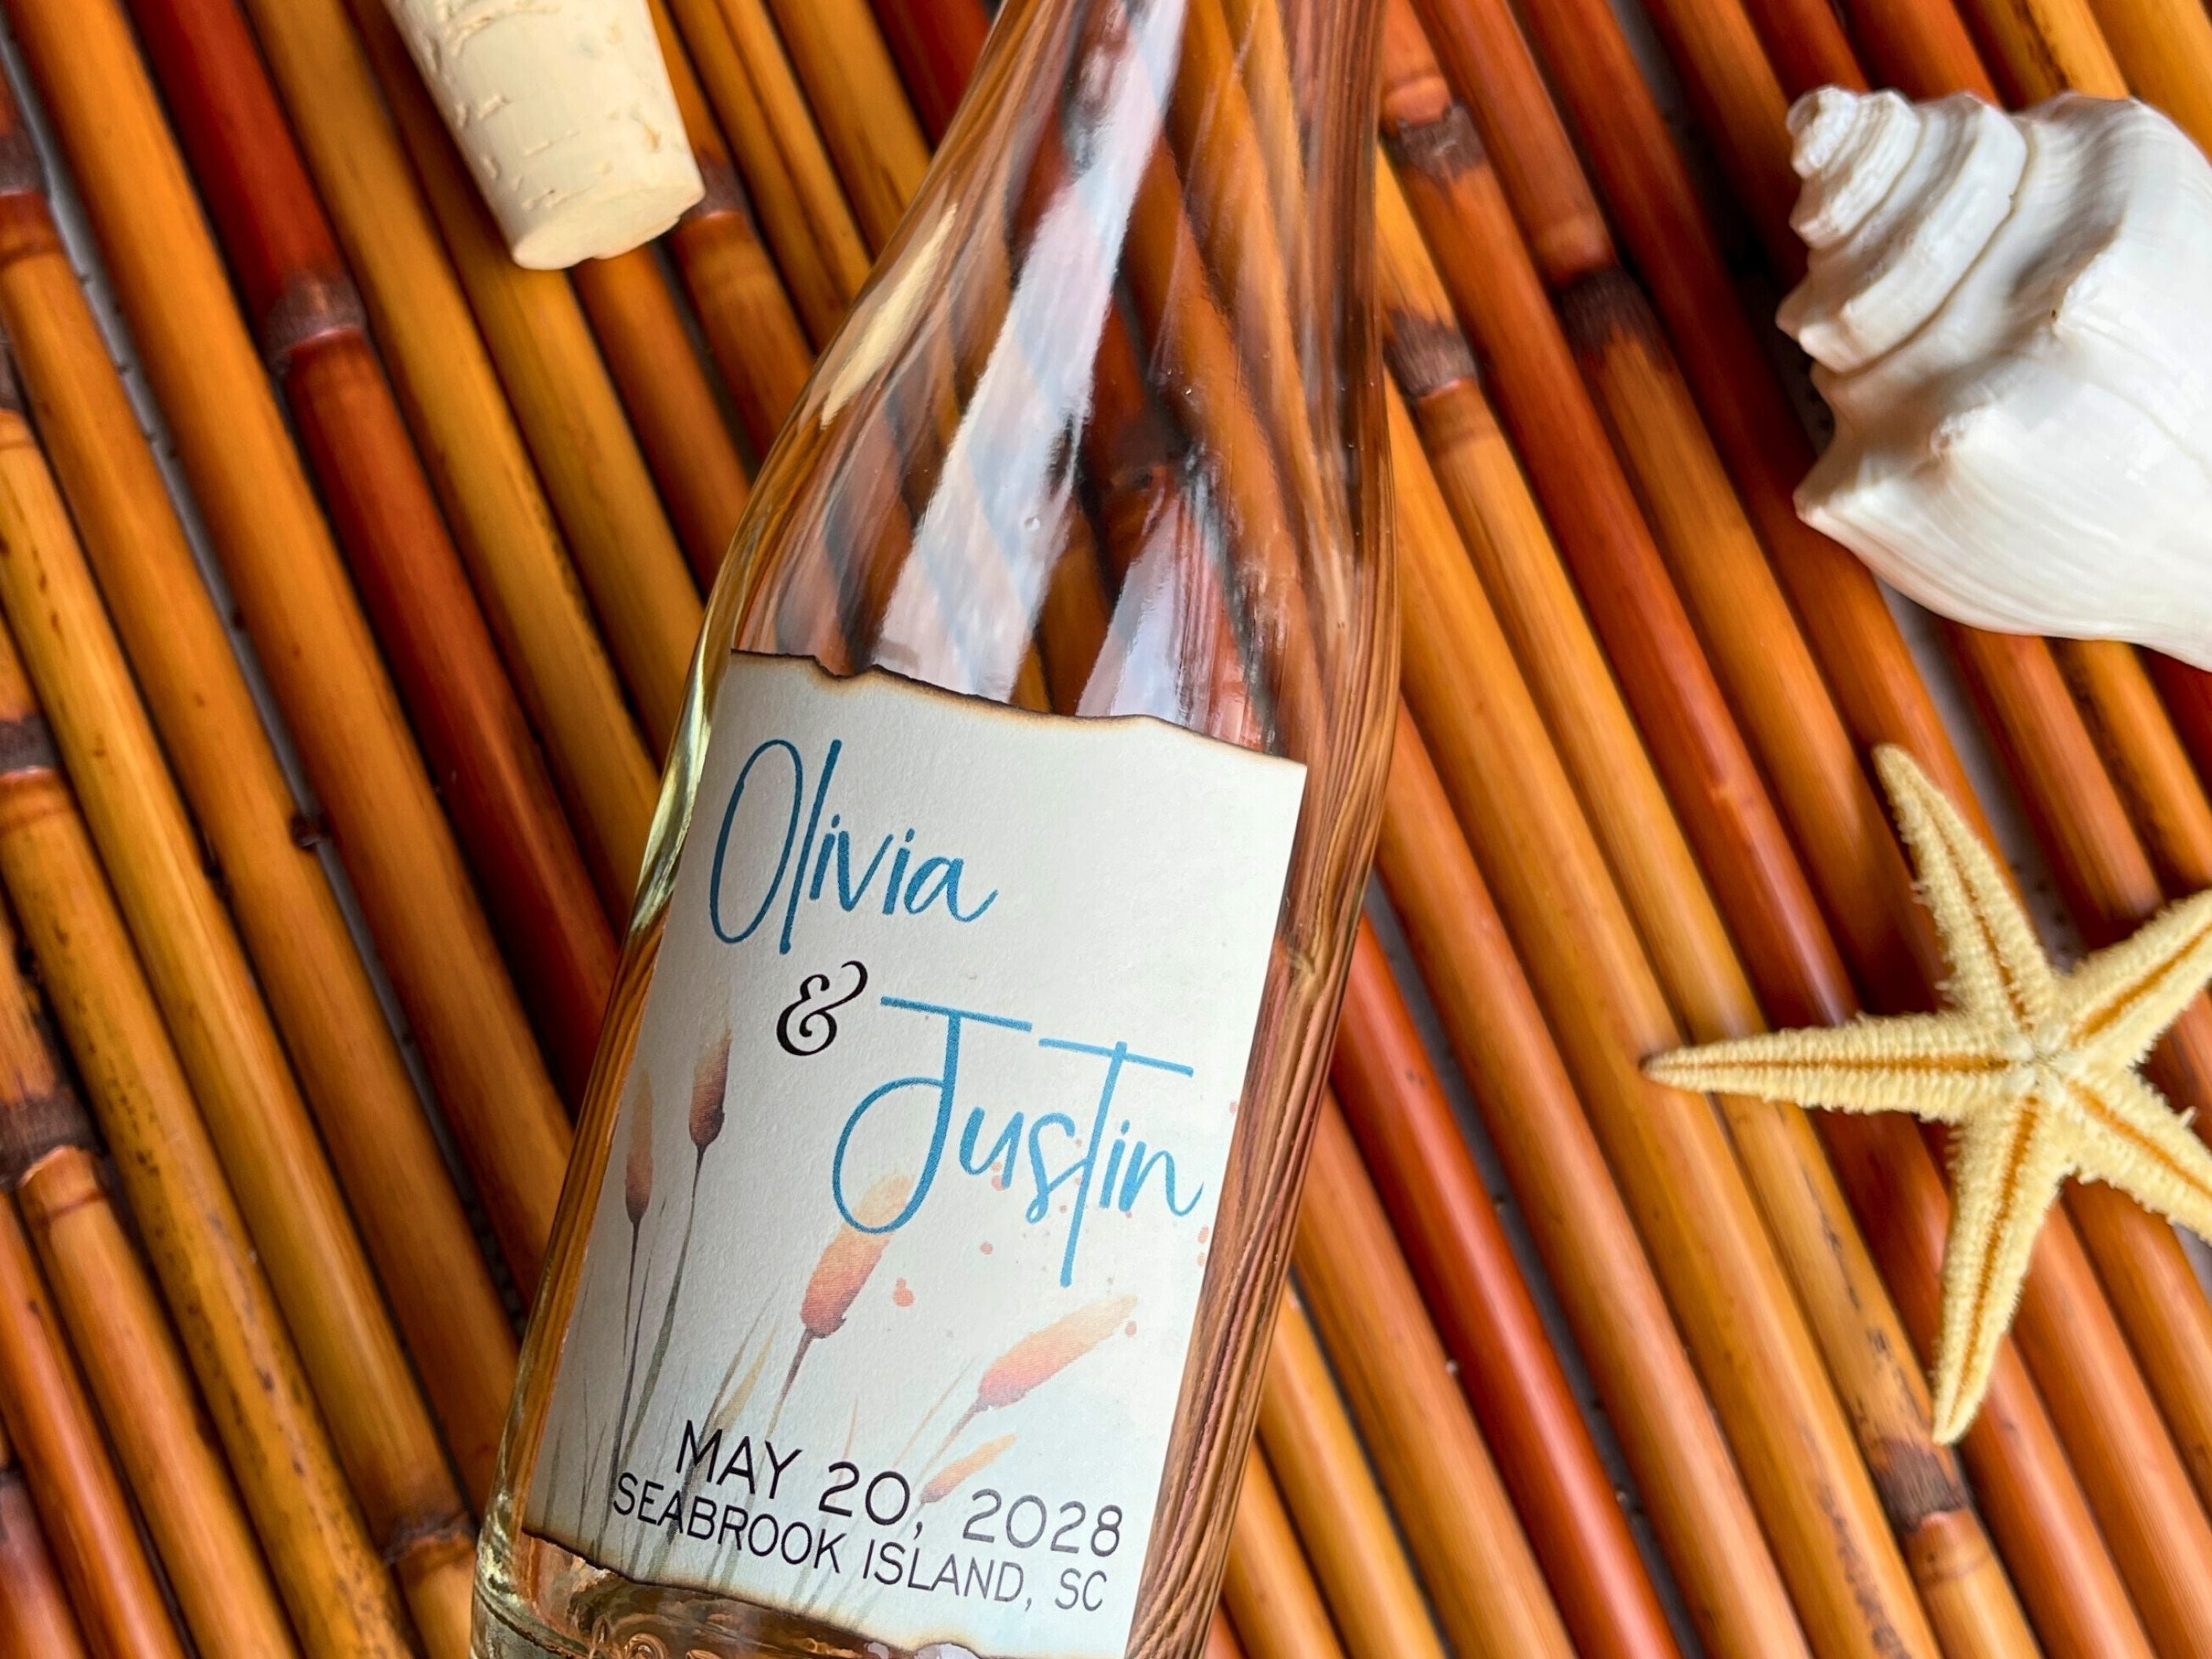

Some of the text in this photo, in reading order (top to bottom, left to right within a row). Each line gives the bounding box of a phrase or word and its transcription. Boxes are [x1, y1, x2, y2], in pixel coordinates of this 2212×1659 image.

[710, 739, 998, 954] Olivia
[776, 961, 1204, 1287] & Justin
[613, 1473, 1107, 1612] SEABROOK ISLAND, SC
[676, 1420, 1122, 1557] MAY 20, 2028
